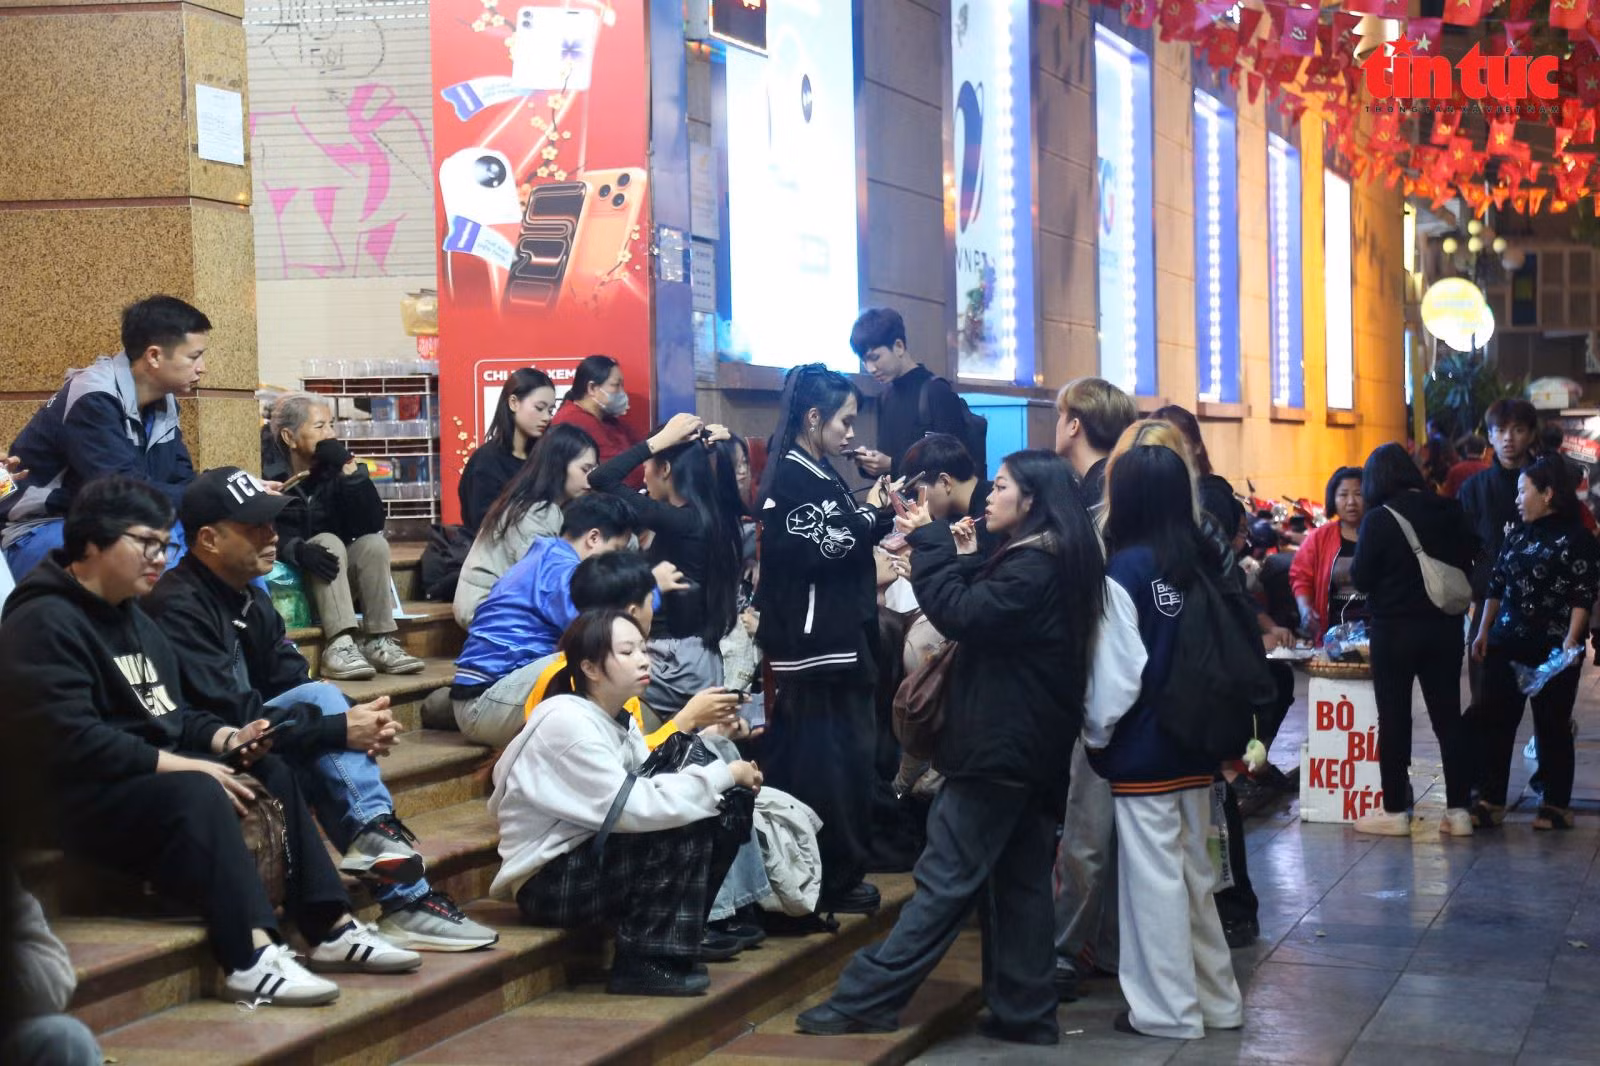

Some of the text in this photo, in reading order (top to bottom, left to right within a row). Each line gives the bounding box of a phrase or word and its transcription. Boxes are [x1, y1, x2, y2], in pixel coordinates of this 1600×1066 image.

[483, 369, 508, 381] CHI
[546, 368, 576, 380] XEM
[1316, 694, 1355, 731] BÒ
[1309, 757, 1356, 795] KẸO
